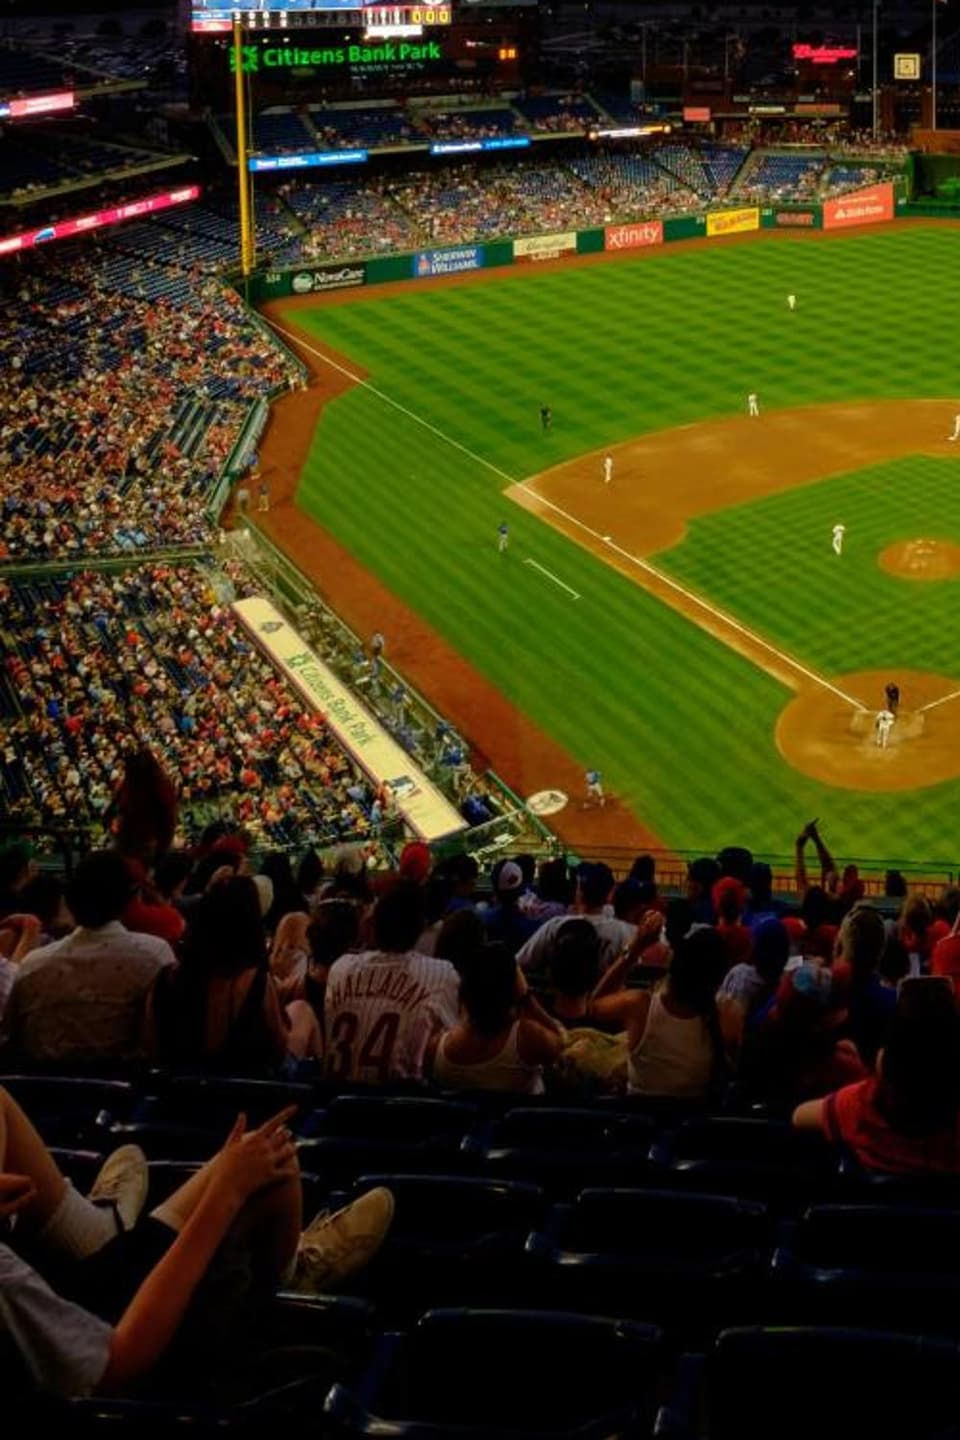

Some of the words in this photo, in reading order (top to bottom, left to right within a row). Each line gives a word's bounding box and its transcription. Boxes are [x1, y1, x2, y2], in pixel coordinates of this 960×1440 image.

[264, 46, 344, 67] Citizens
[349, 44, 396, 63] Bank
[400, 42, 441, 60] Park
[608, 224, 658, 249] xfinity
[326, 697, 356, 725] Bank
[350, 717, 378, 746] Park
[331, 968, 431, 1012] HALLADAY
[328, 1012, 399, 1079] 34
